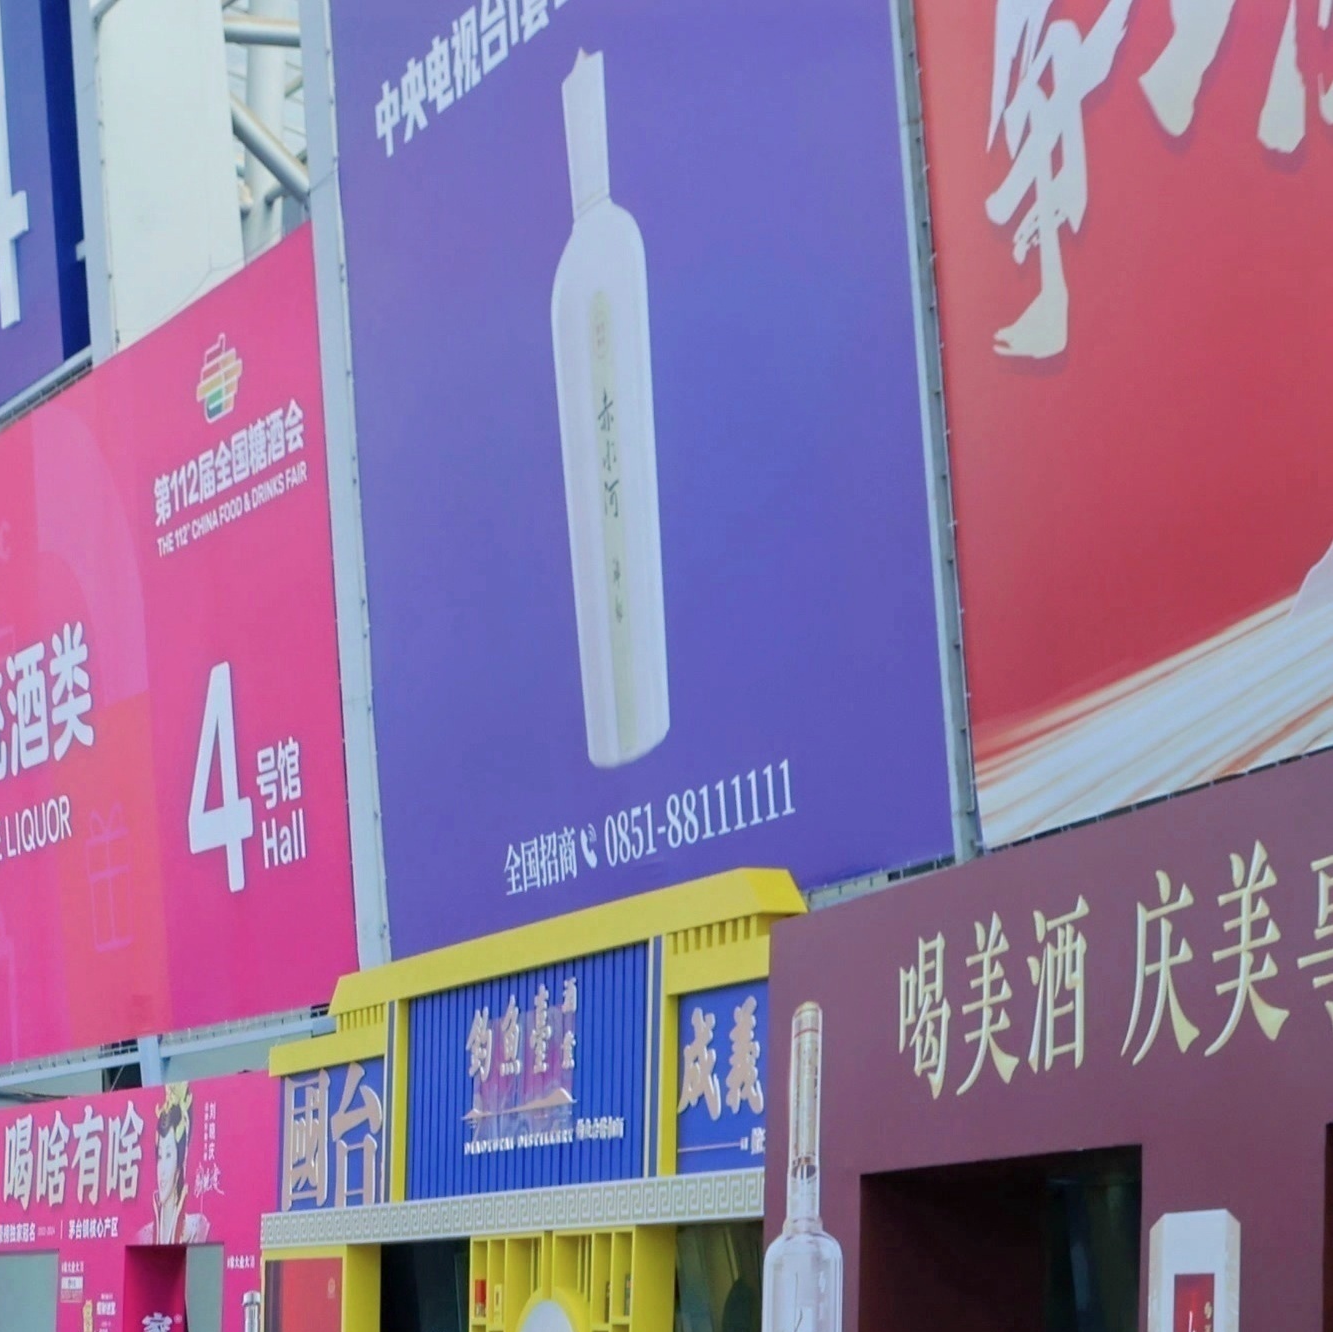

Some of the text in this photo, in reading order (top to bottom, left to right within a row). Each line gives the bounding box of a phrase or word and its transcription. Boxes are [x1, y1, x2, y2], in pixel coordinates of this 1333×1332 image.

[154, 398, 304, 527] 第112届全国糖酒会
[6, 795, 72, 859] LIQUOR
[188, 661, 253, 892] 4
[256, 739, 301, 810] 号馆
[504, 759, 796, 896] 全国招商 0851-88111111
[261, 810, 307, 869] Hall
[898, 894, 1090, 1100] 喝美酒
[3, 1099, 144, 1214] 喝啥有啥
